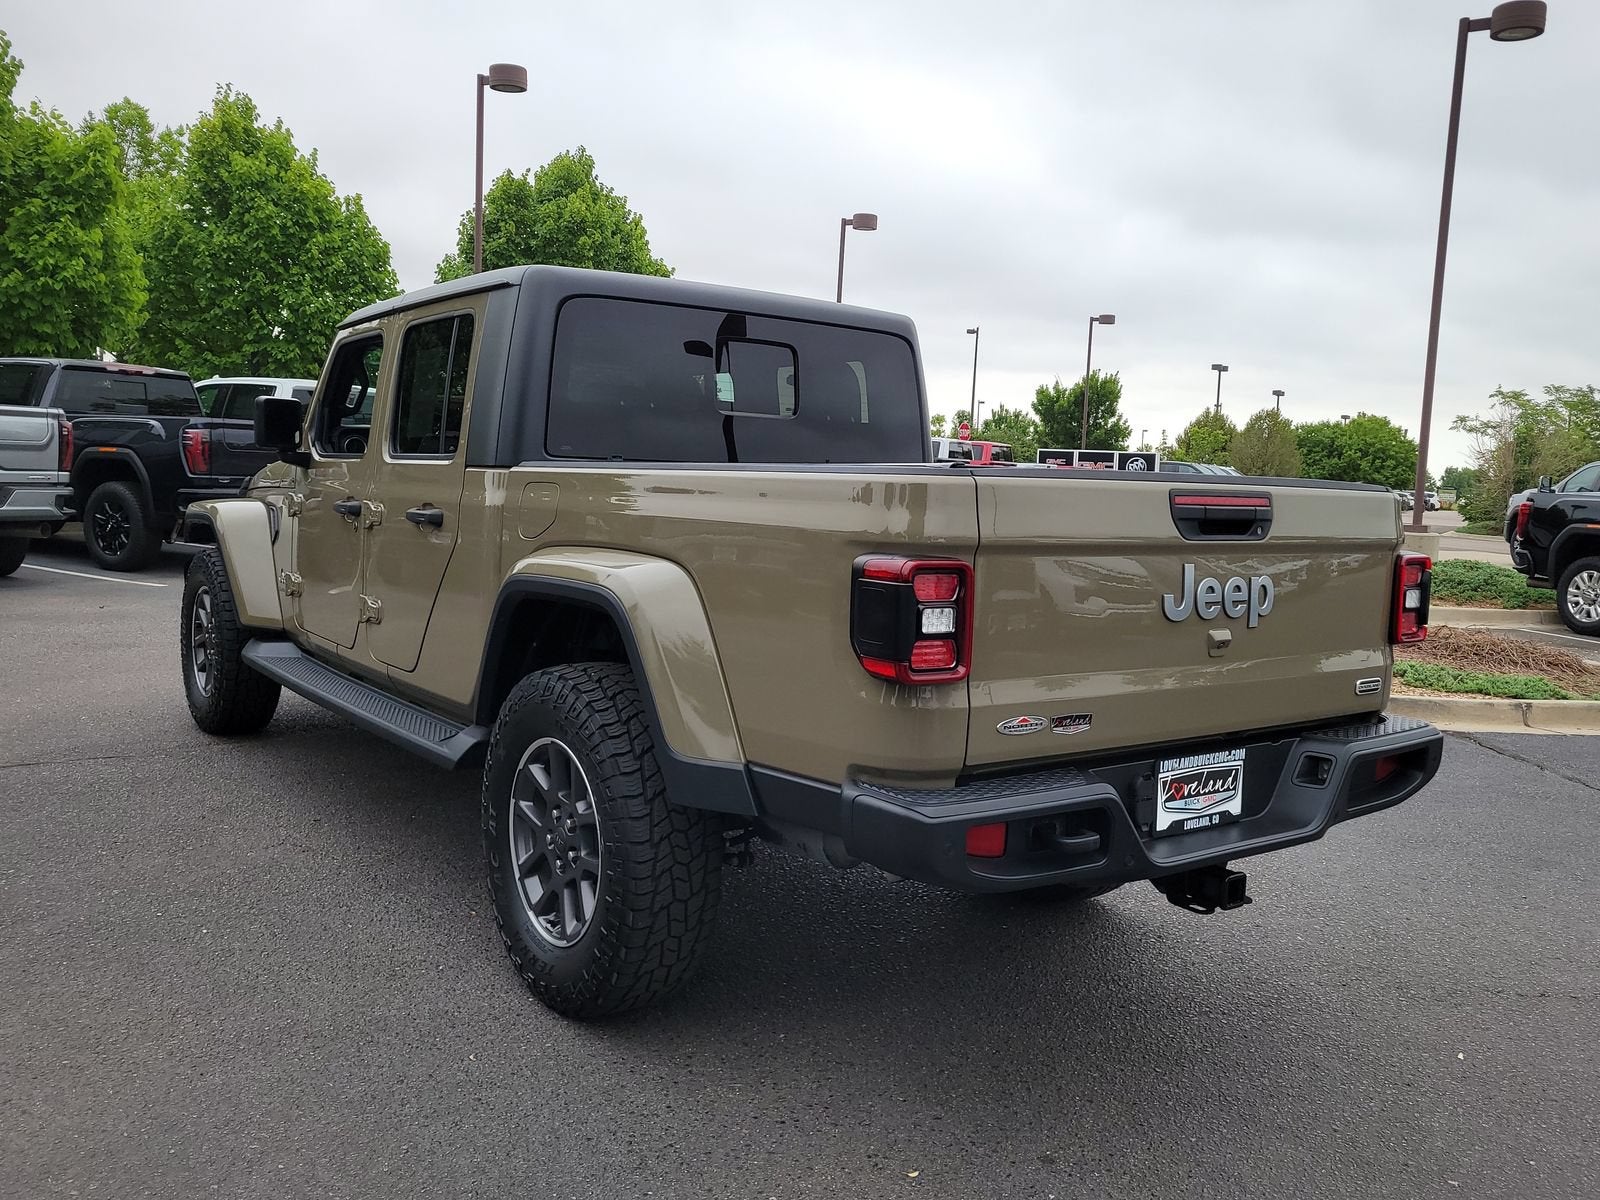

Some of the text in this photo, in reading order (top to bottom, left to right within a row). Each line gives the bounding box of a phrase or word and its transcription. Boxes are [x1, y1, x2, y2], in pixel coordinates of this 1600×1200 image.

[959, 428, 971, 437] STOP
[1078, 462, 1114, 470] GMC
[1162, 563, 1275, 629] Jeep
[1003, 721, 1043, 730] NORTH
[1160, 748, 1246, 773] LOVELANDBUICKGMC.COM
[1184, 795, 1217, 807] BUICK GMC
[1184, 814, 1220, 830] LOVELAND, CO
